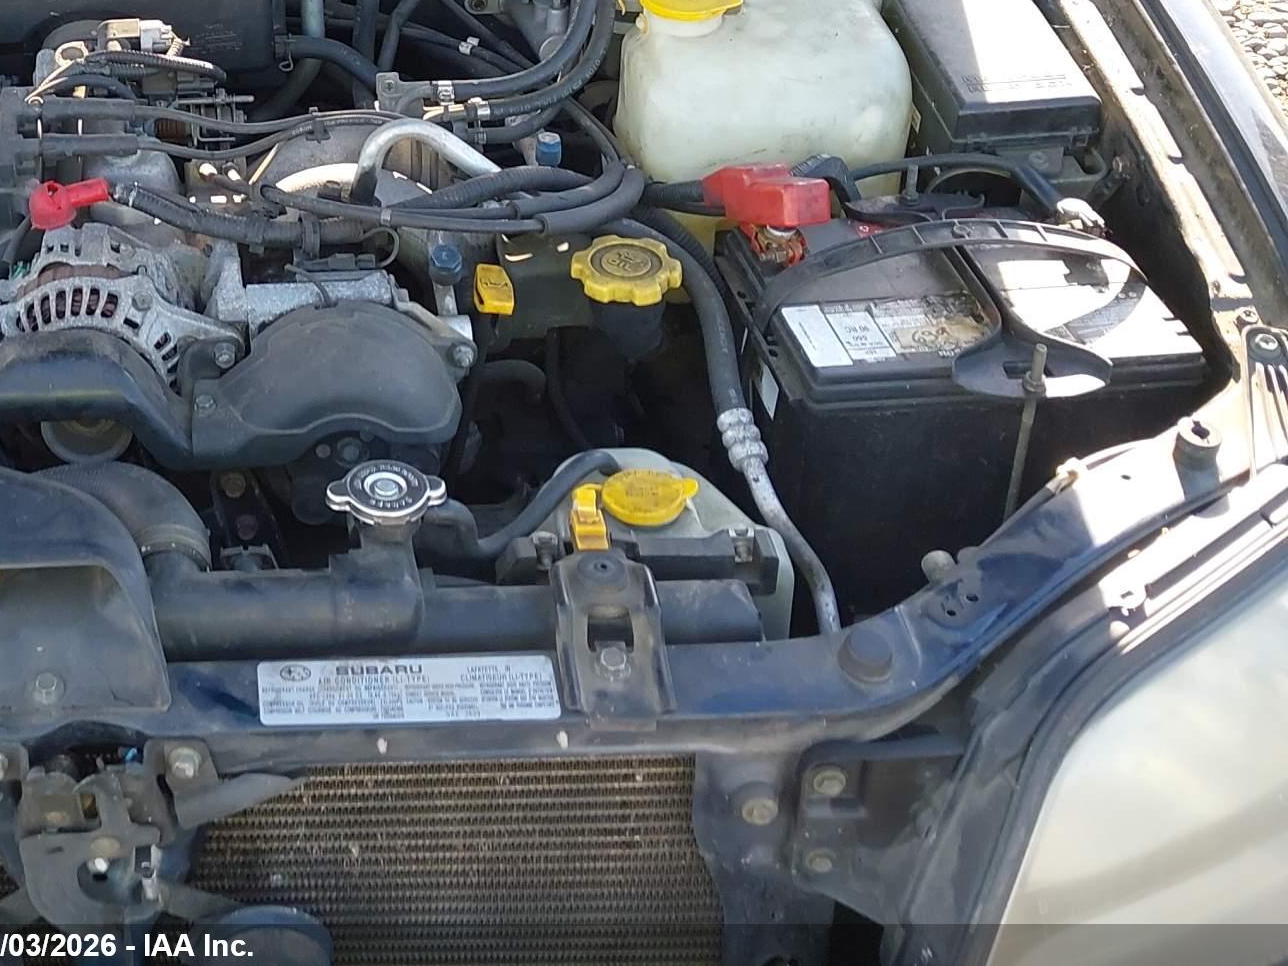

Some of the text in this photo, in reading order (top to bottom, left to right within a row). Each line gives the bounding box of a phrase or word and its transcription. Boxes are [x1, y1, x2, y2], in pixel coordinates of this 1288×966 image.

[336, 664, 423, 675] SUBARU
[318, 677, 331, 685] AIR
[334, 676, 390, 684] CONDITIONER
